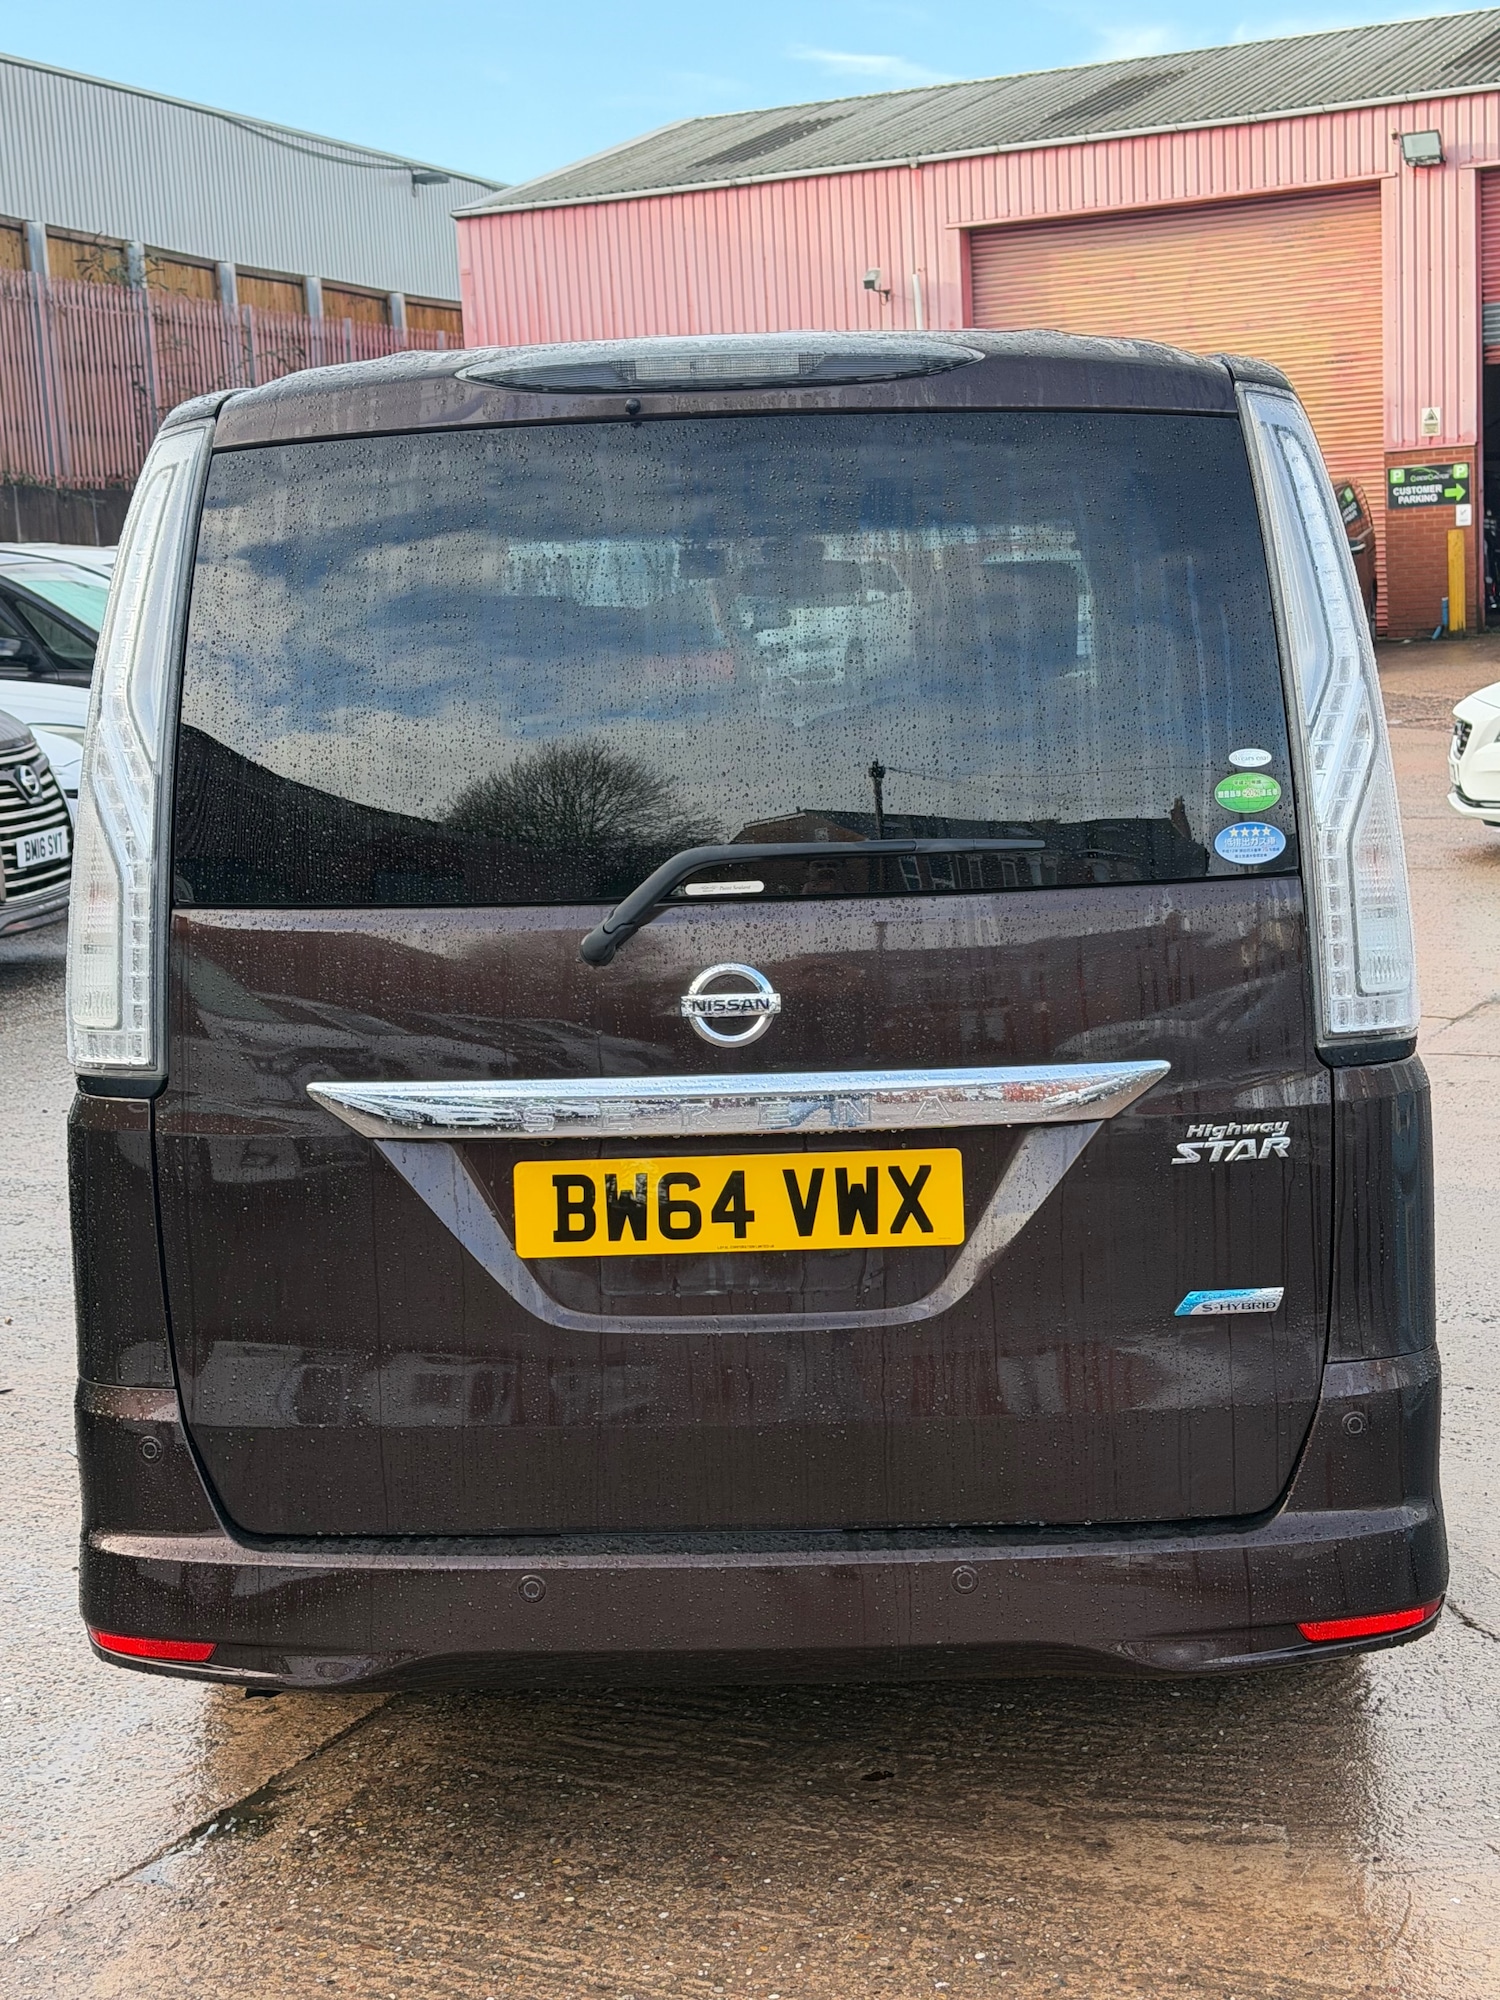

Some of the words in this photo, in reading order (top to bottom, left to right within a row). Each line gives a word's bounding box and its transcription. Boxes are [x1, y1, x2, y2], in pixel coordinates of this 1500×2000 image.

[1394, 470, 1402, 482] P
[1456, 465, 1465, 478] P
[1392, 484, 1443, 496] CUSTOMER
[1398, 494, 1438, 505] PARKING
[692, 998, 770, 1012] NISSAN
[522, 1095, 952, 1131] SERENA
[1186, 1121, 1290, 1142] Highway
[1171, 1137, 1291, 1165] STAR
[552, 1170, 755, 1243] BW64
[782, 1164, 934, 1236] VWX
[1202, 1301, 1276, 1313] S-HYBRID
